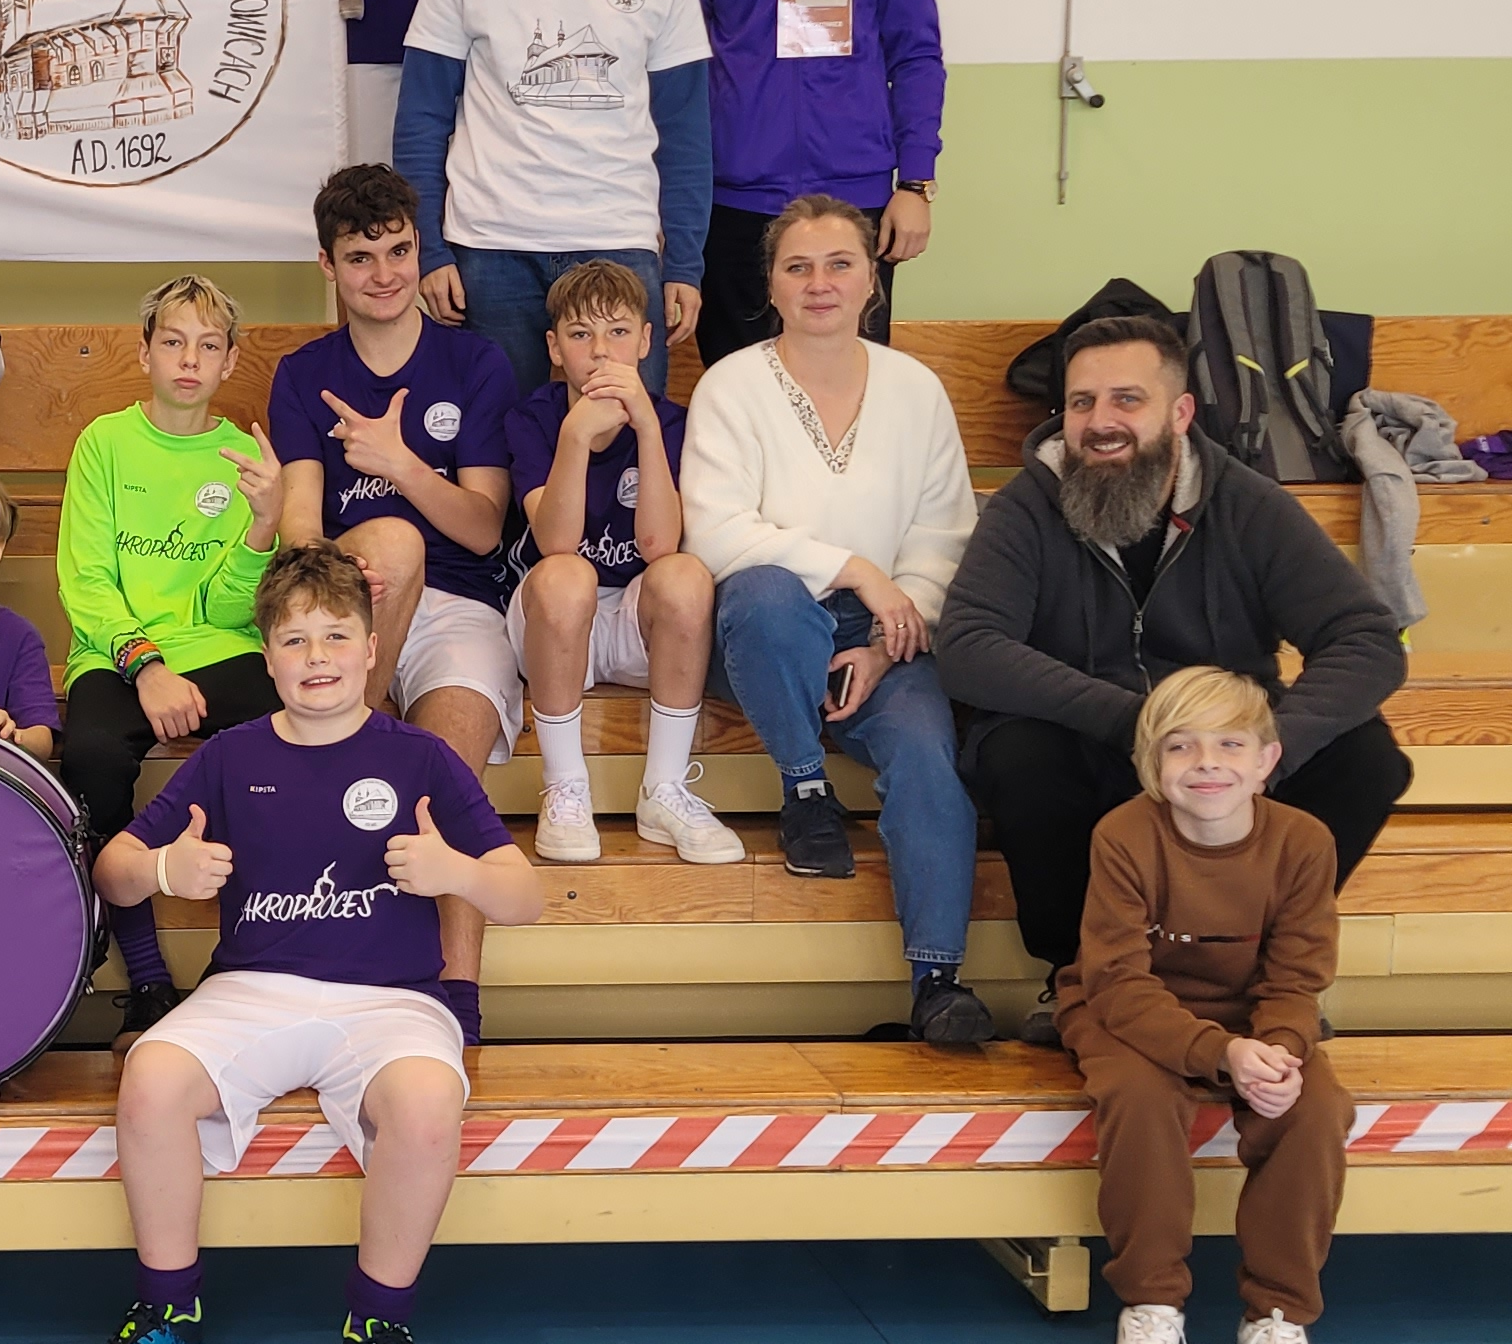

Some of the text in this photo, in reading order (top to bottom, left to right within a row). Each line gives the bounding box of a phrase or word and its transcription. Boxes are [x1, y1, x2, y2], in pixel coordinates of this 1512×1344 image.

[124, 483, 147, 494] KIPSTA
[116, 525, 219, 561] AKROPROCES
[249, 785, 276, 793] KIPSTA
[237, 880, 387, 928] AKROPROCES
